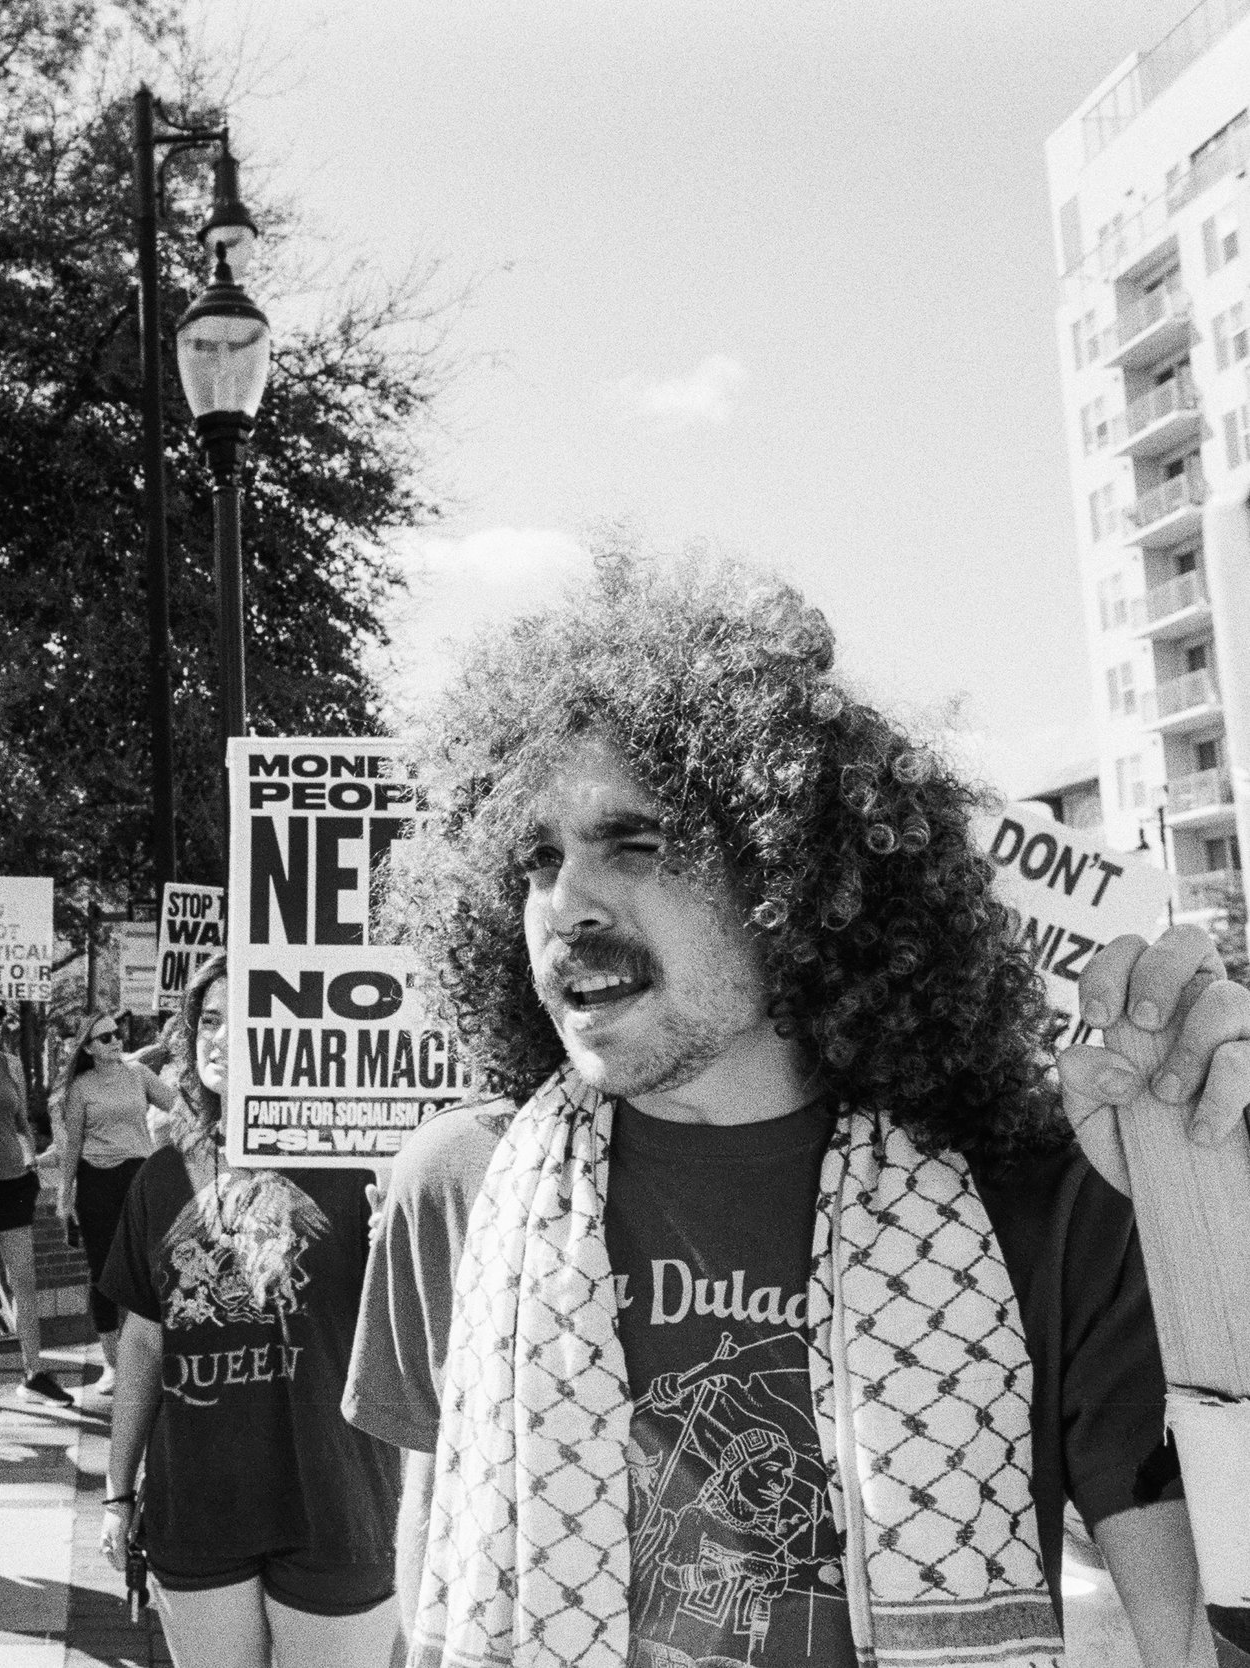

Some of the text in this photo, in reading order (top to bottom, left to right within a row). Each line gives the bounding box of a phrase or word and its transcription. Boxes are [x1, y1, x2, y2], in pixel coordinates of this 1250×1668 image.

[989, 818, 1123, 907] DON'T
[168, 891, 212, 919] STOP
[161, 950, 190, 991] ON
[248, 970, 415, 1020] NO
[247, 1027, 347, 1087] WAR
[248, 1100, 437, 1127] PARTY FOR SOCIALISM &
[248, 1128, 402, 1151] PSLWE
[161, 1343, 303, 1406] QUEEN
